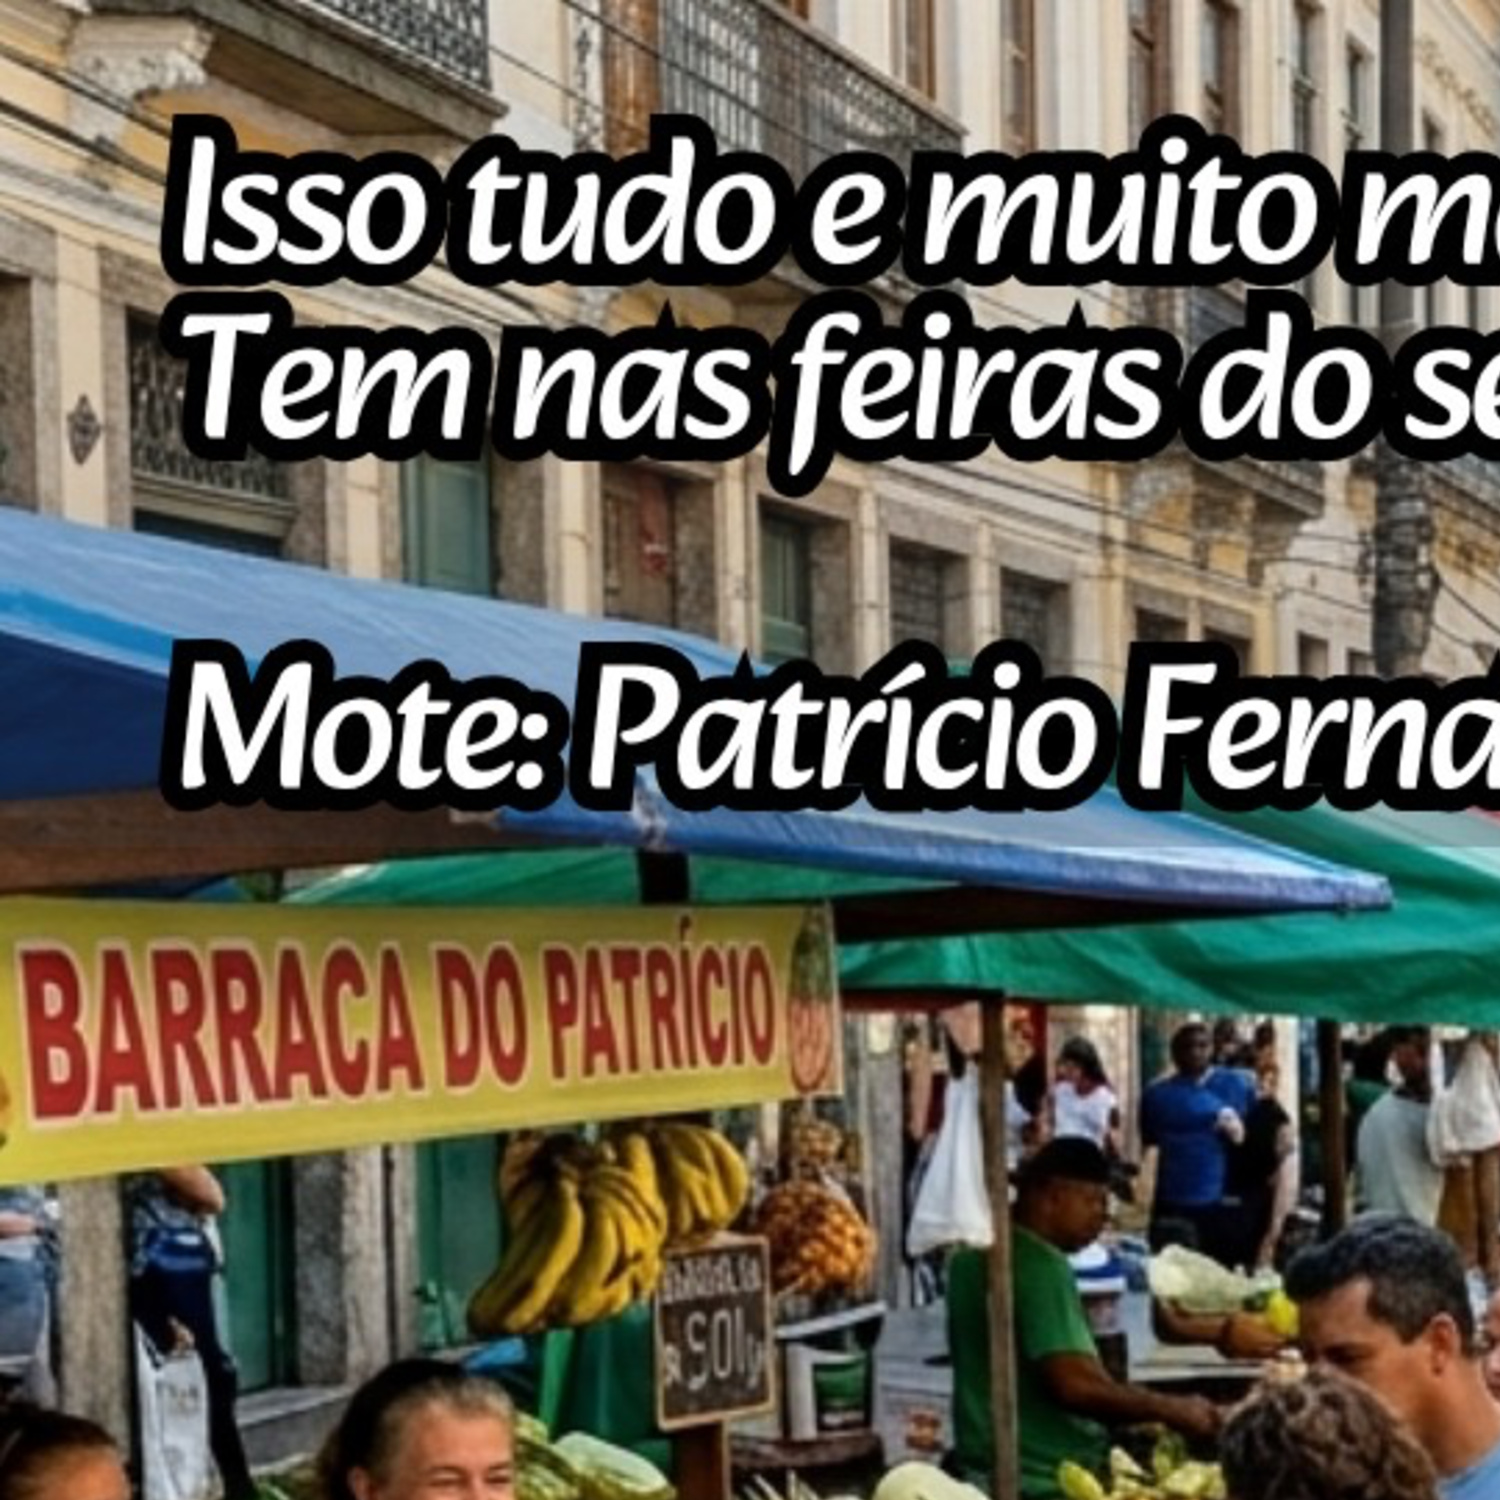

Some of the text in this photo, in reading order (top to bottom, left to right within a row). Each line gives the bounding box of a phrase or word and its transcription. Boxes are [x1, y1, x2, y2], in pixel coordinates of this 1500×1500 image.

[21, 917, 777, 1119] BARRACA DO PATRÍCIO
